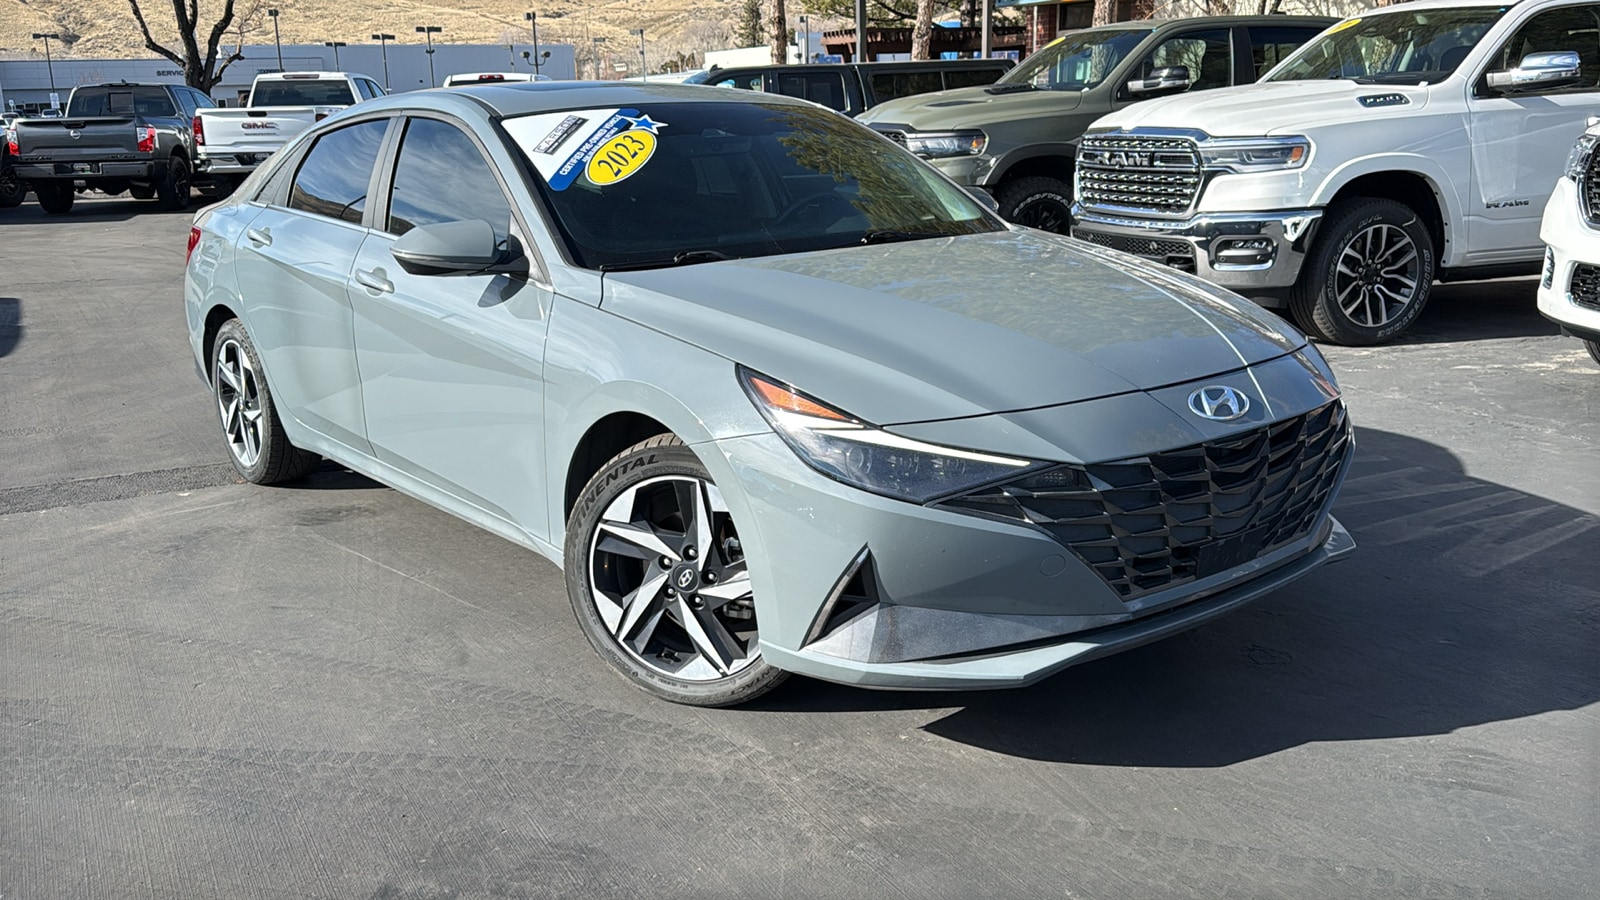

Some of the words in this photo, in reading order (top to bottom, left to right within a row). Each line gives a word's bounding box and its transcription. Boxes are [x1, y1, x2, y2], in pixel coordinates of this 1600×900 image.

[241, 122, 277, 130] GMC
[537, 114, 578, 152] CARSON
[597, 135, 646, 177] 2023
[1093, 151, 1151, 166] RAM
[1012, 192, 1069, 217] GOODYEA
